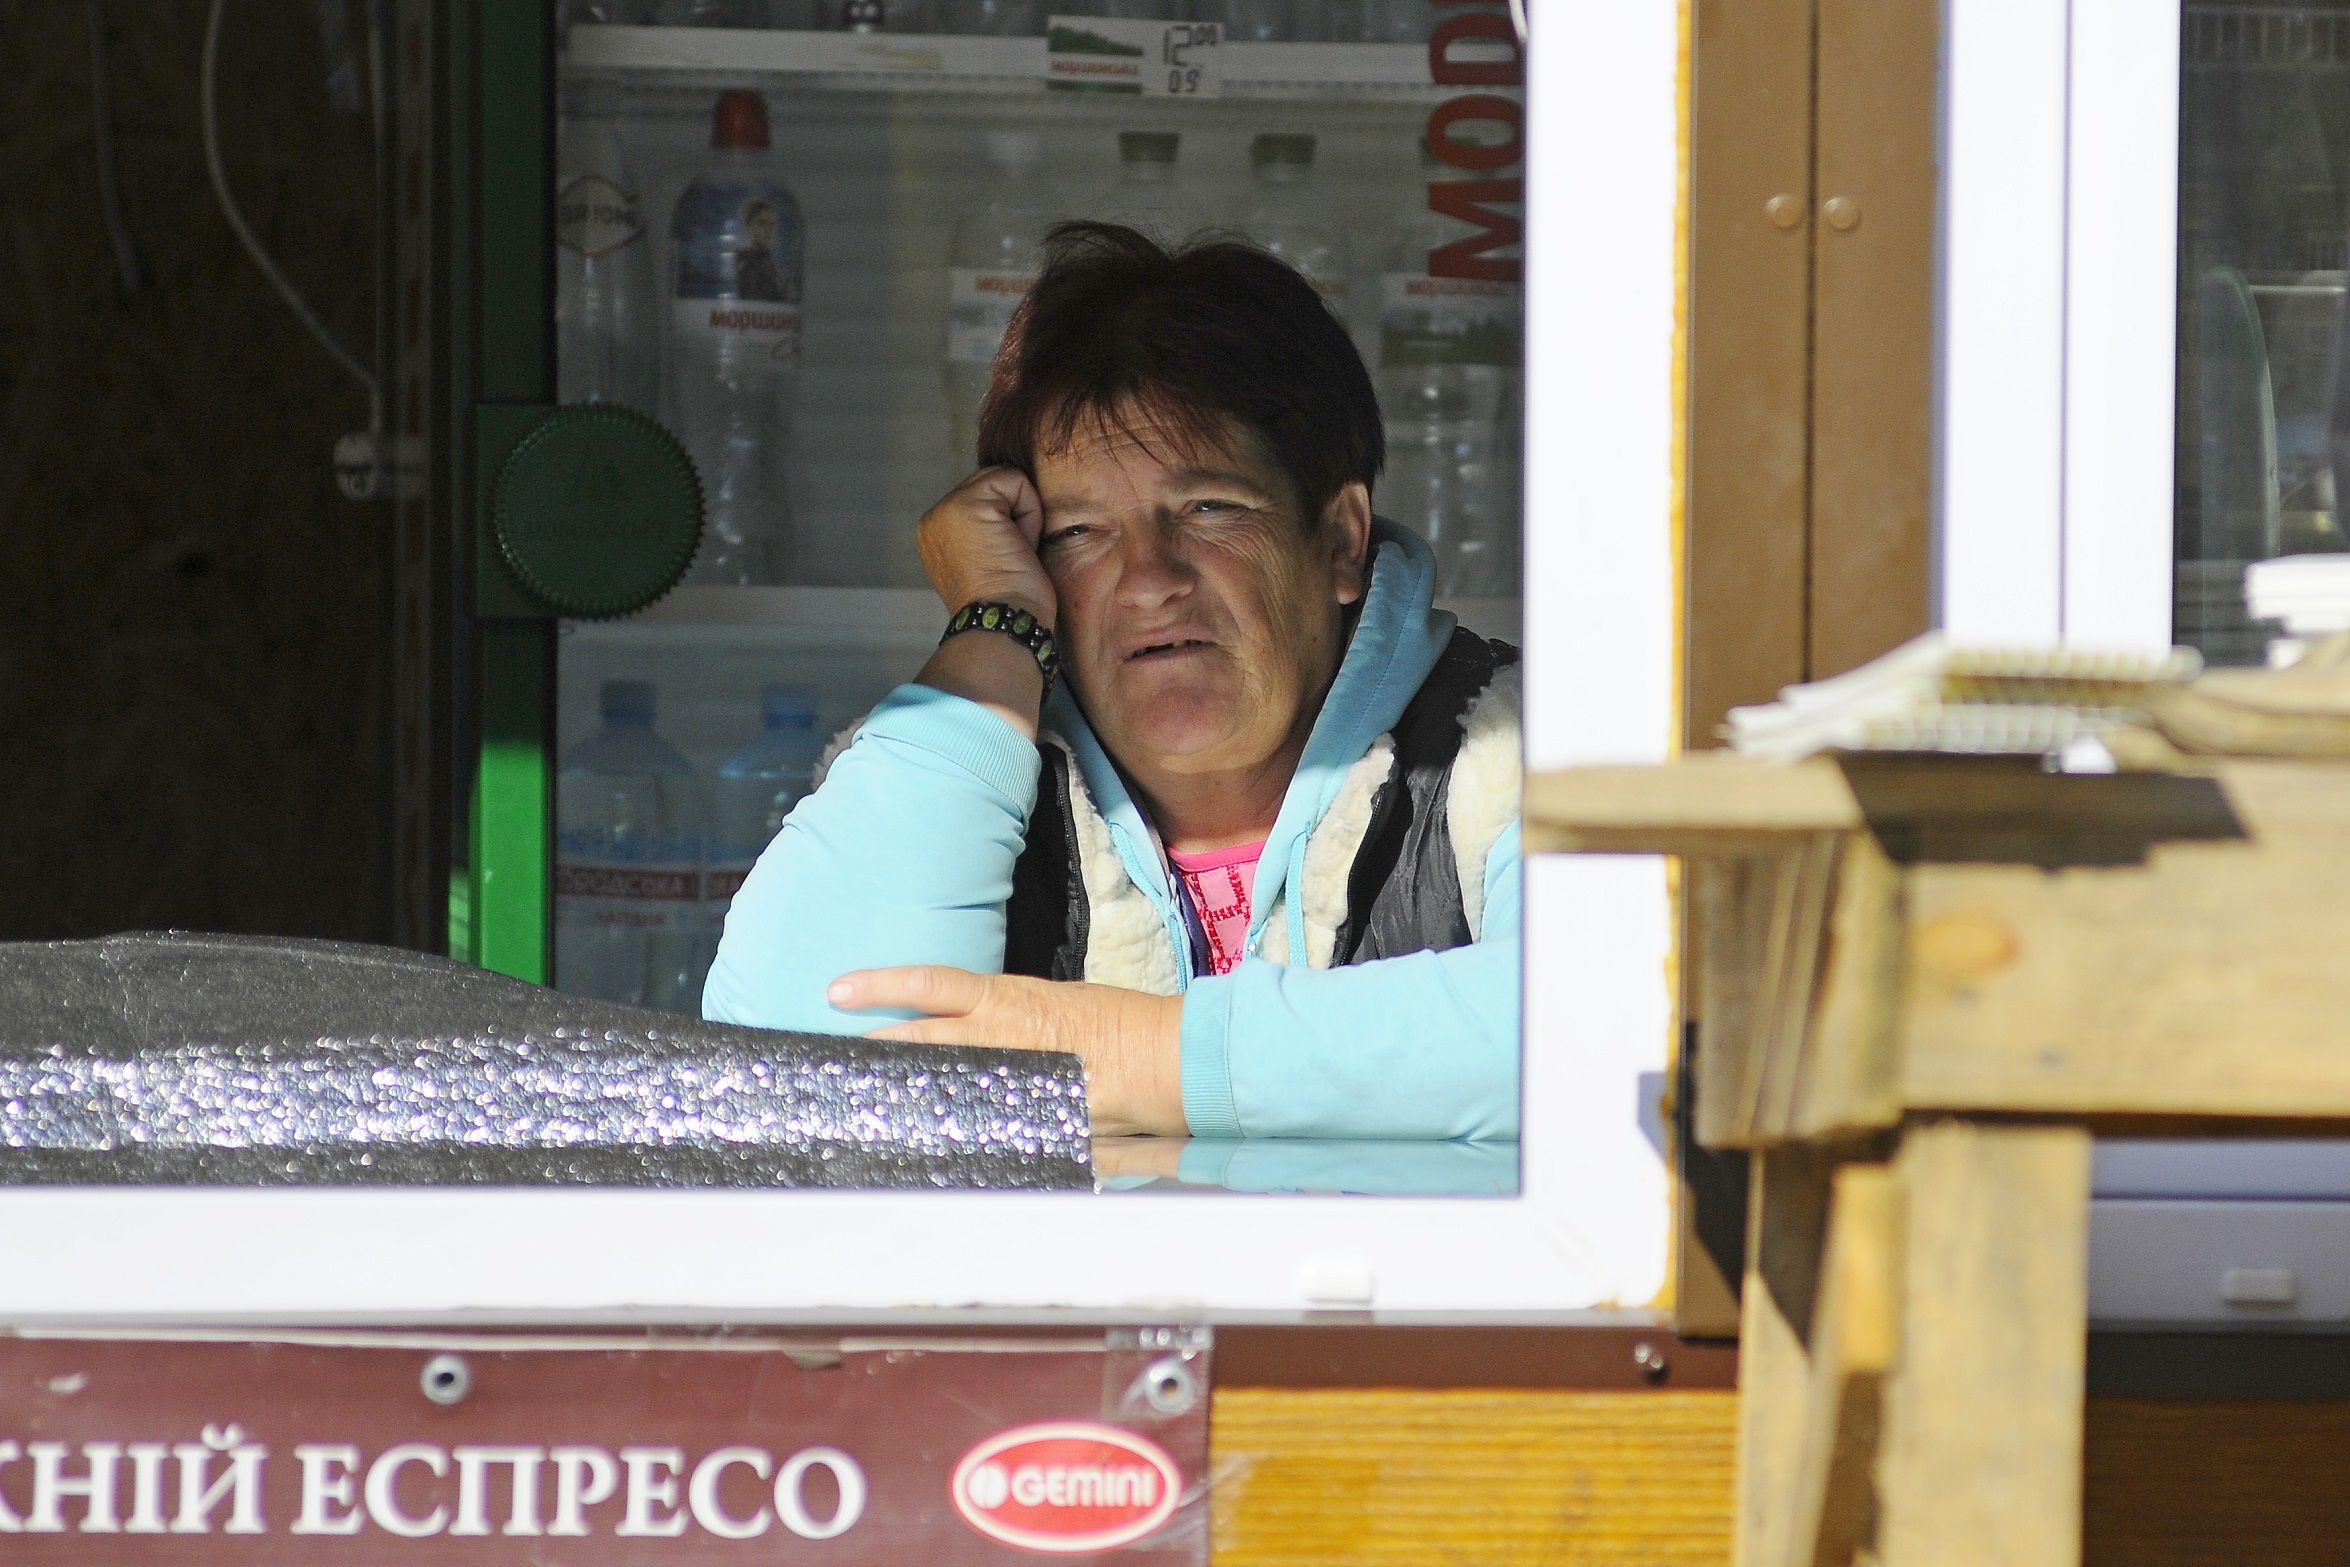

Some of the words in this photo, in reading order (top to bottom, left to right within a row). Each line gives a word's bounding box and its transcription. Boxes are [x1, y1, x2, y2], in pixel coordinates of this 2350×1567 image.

[0, 1422, 269, 1535] НІЙ
[289, 1444, 867, 1539] ЕСПРЕСО
[1010, 1463, 1157, 1507] GEMINI
